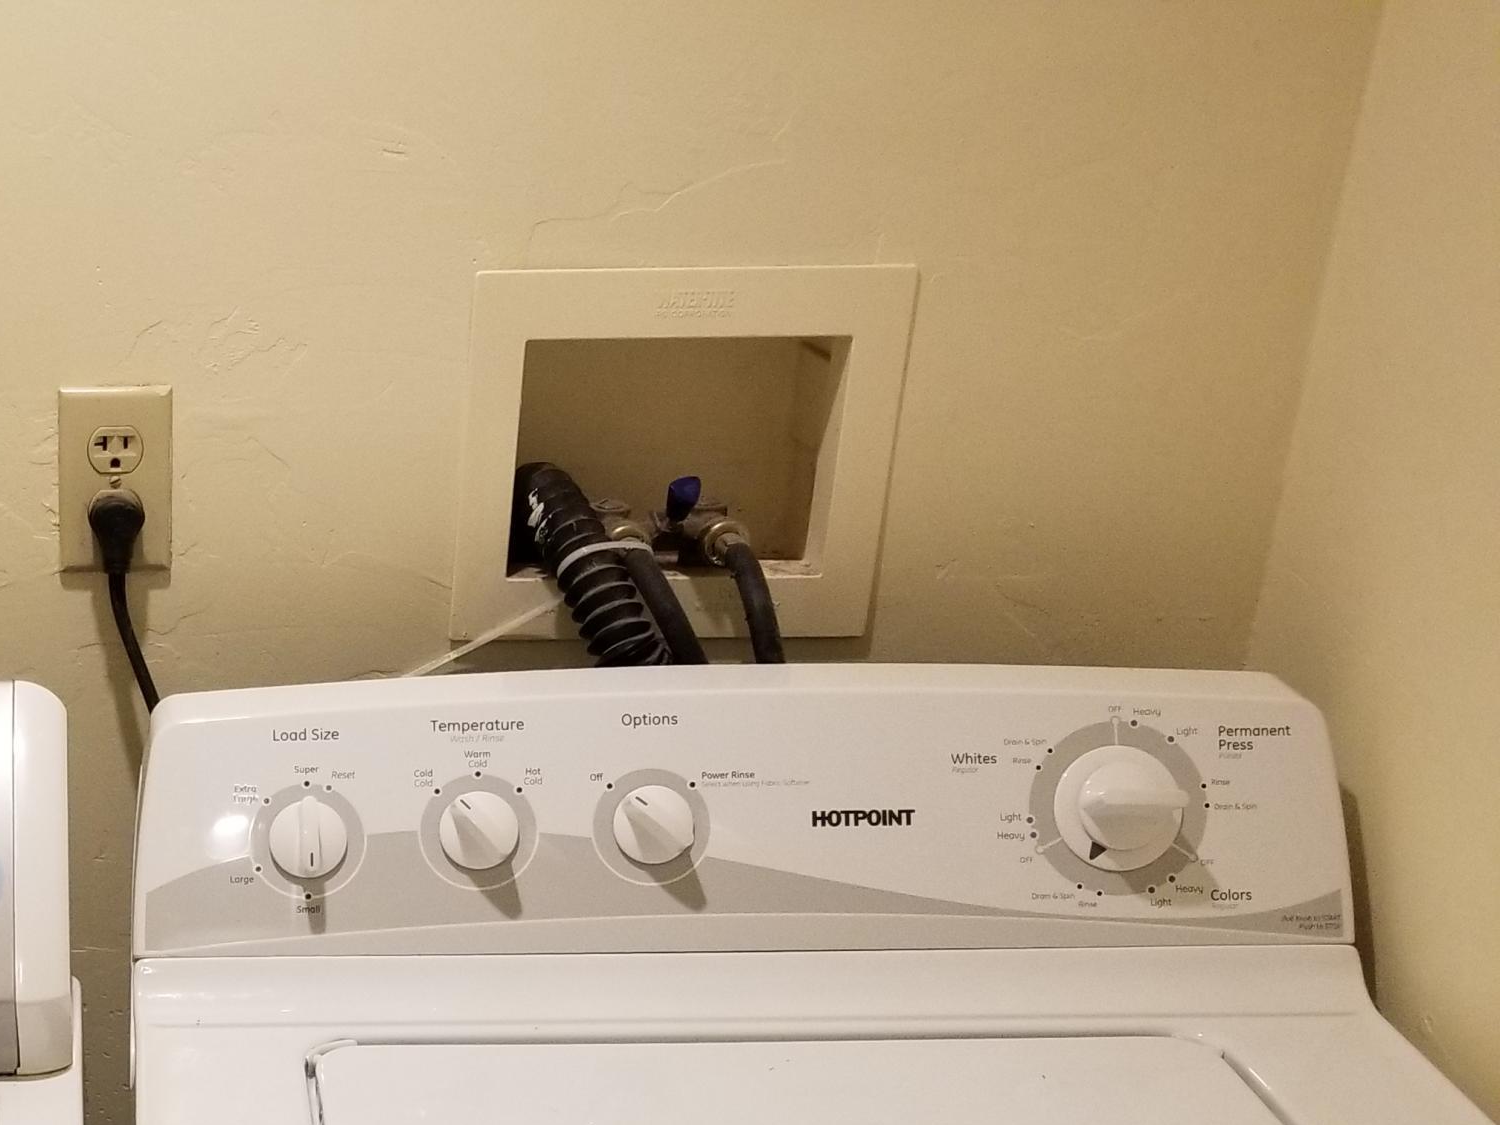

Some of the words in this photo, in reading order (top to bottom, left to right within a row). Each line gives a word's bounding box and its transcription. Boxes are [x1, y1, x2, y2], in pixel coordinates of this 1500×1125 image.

[1133, 708, 1161, 716] Heavy
[621, 712, 678, 728] Options
[430, 720, 524, 734] Temperature
[1218, 726, 1291, 737] Permanent
[272, 729, 307, 741] Load
[312, 728, 340, 740] Size
[1176, 728, 1198, 736] Light
[1219, 740, 1254, 750] Press
[464, 750, 490, 758] Warm
[951, 753, 997, 764] Whites
[468, 760, 487, 768] Cold
[294, 766, 318, 774] Super
[414, 769, 432, 778] Cold
[332, 771, 355, 779] Reset
[414, 779, 432, 787] Cold
[524, 777, 542, 785] Cold
[811, 809, 915, 827] HOTPOINT
[1000, 812, 1022, 824] Light
[997, 832, 1025, 842] Heavy
[230, 876, 254, 884] Large
[1176, 885, 1203, 894] Heavy
[1211, 889, 1252, 901] Colors
[1150, 898, 1172, 908] Light
[296, 906, 320, 914] Small
